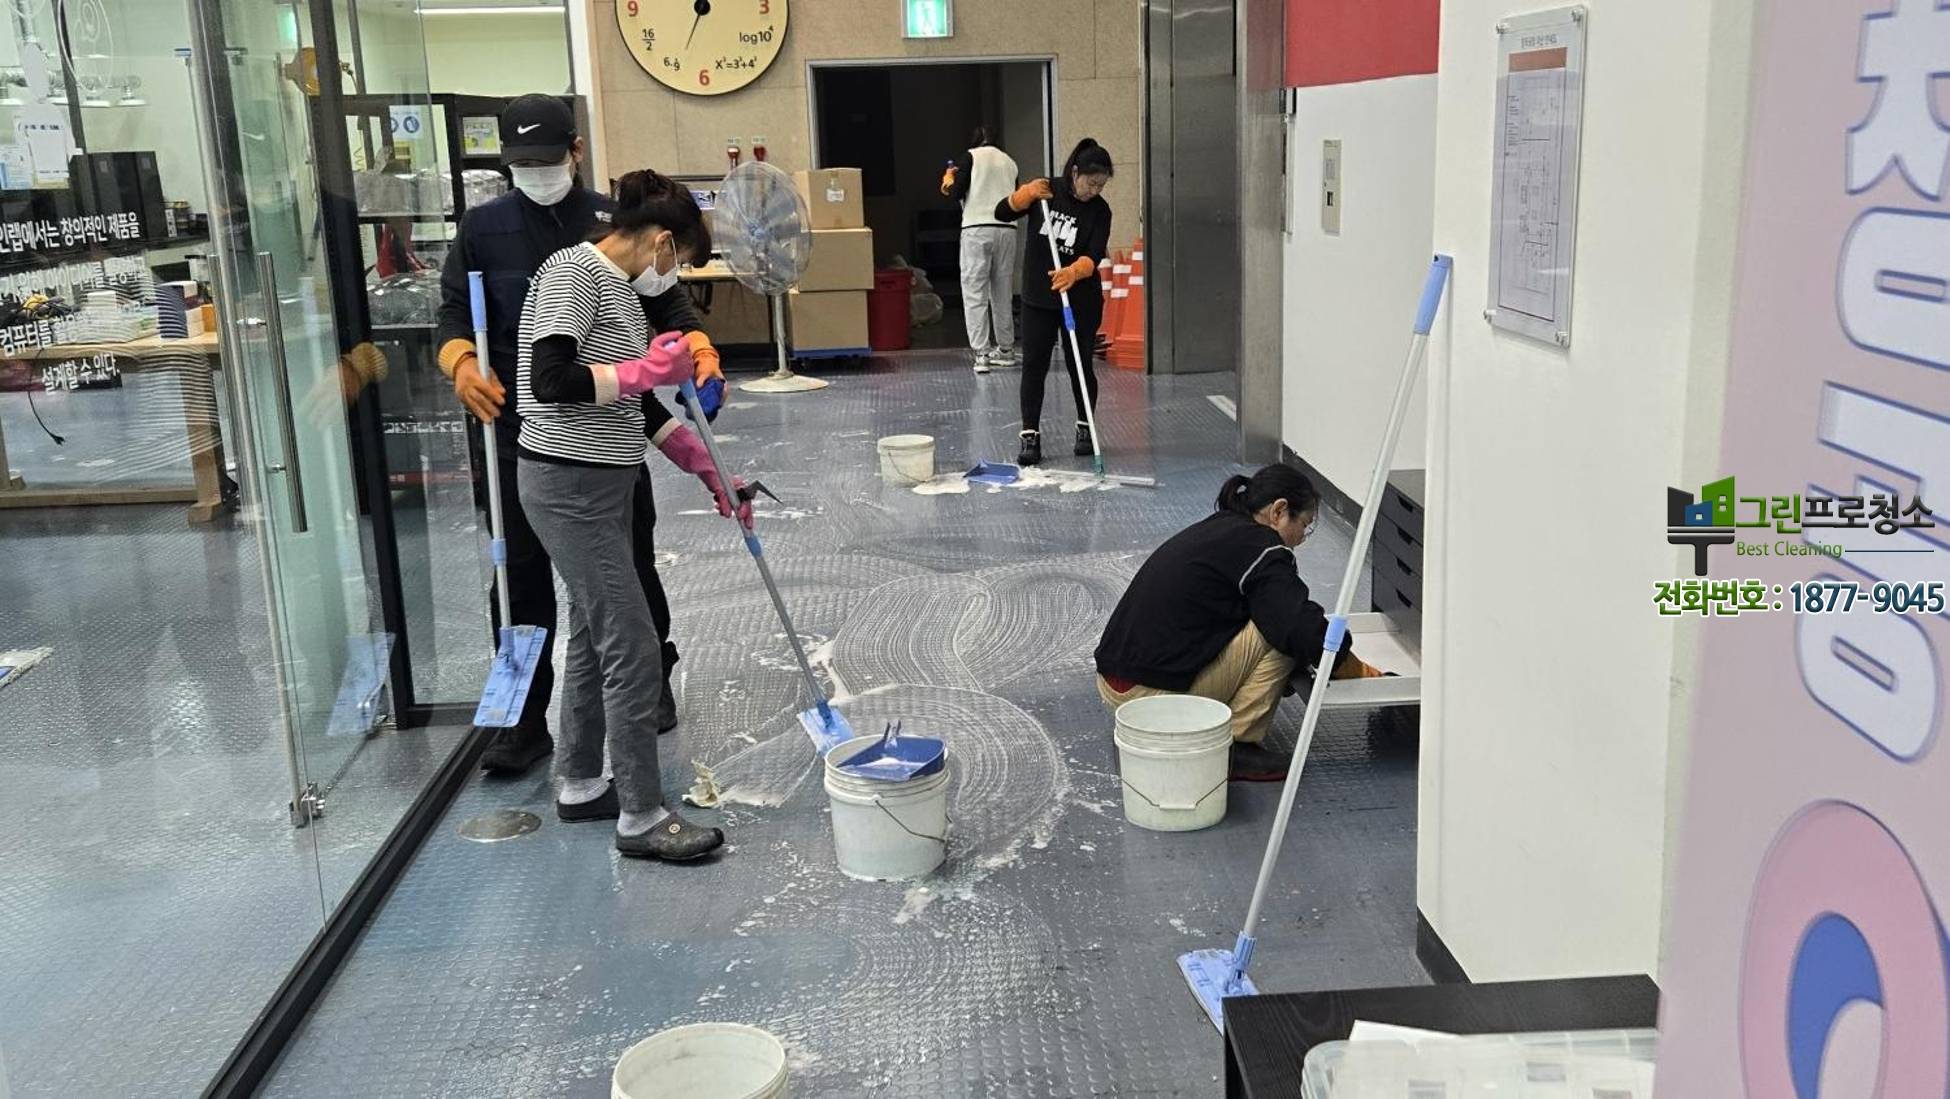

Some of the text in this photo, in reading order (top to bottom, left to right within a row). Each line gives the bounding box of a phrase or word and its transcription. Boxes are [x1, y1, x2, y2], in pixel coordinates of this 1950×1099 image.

[627, 1, 639, 17] 9
[759, 0, 770, 14] 3
[700, 70, 710, 86] 6
[60, 215, 108, 247] 창의적인
[107, 211, 141, 239] 제품을
[0, 319, 52, 357] 컴퓨터를
[41, 352, 120, 395] 설계할 수 있다.
